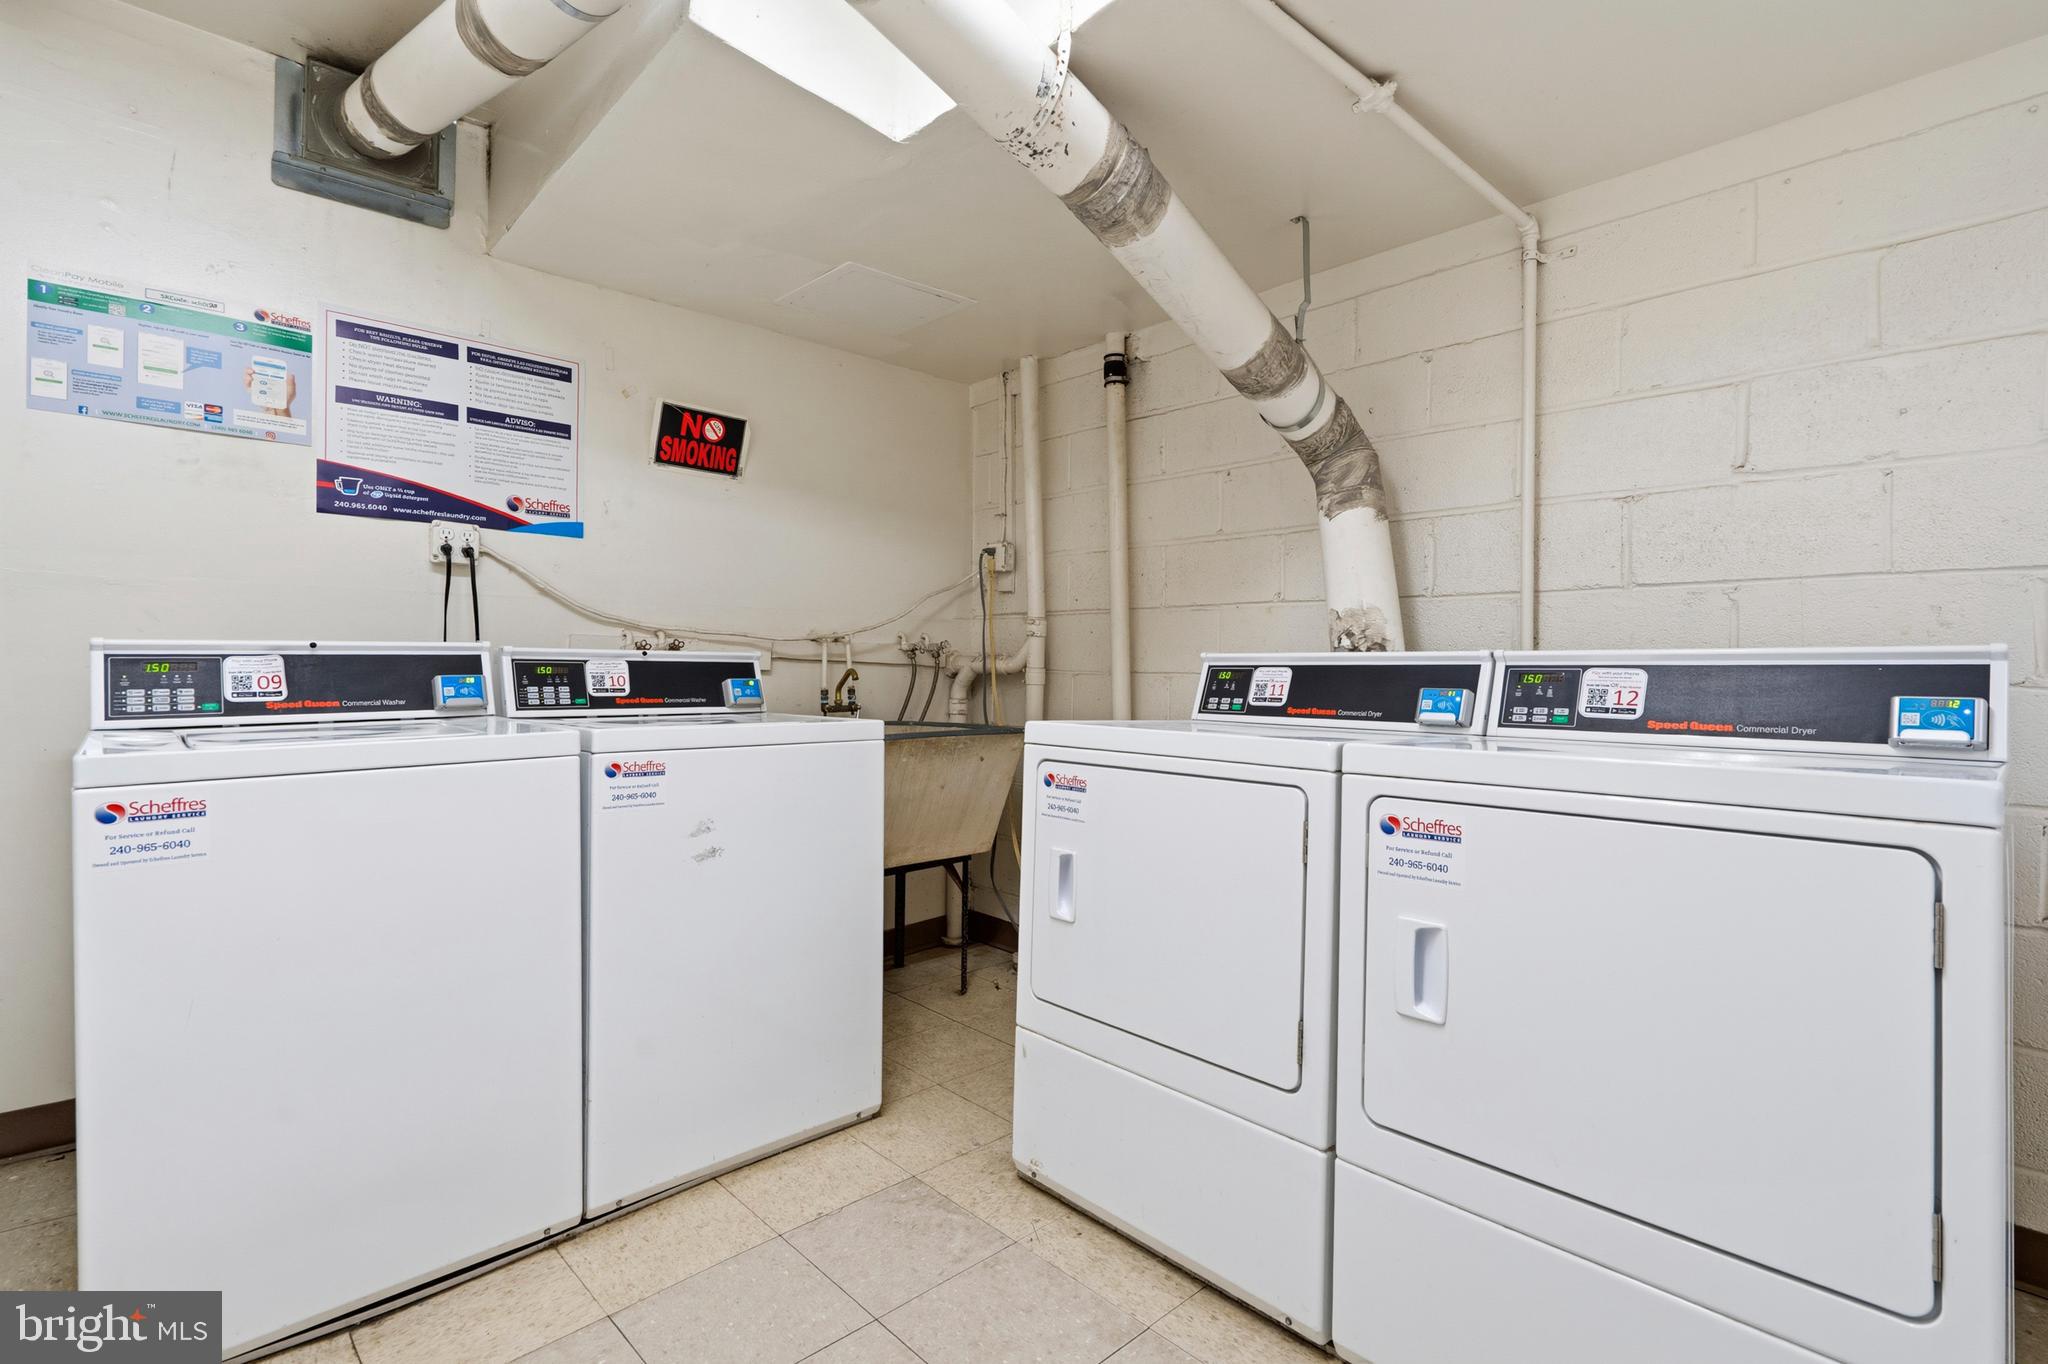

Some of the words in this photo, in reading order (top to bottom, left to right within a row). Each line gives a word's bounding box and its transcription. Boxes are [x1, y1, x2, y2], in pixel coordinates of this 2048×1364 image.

[88, 275, 125, 288] Mobile
[143, 304, 151, 313] 2
[236, 323, 245, 331] 3
[271, 312, 311, 329] Scheffres
[376, 394, 422, 408] WARNING:
[505, 416, 536, 428] ADVISO:
[660, 435, 737, 472] SMOKING
[334, 500, 388, 511] 240.965.6040
[393, 507, 487, 521] www.scheffreslaundry.com
[525, 498, 570, 513] Scheffres
[258, 674, 282, 690] 09
[609, 675, 626, 687] 10
[1270, 684, 1284, 696] 11
[616, 697, 640, 705] Speed
[640, 696, 664, 704] Queen
[1613, 690, 1639, 706] 12
[266, 700, 302, 711] Speed
[304, 700, 340, 708] Queen
[1287, 706, 1311, 716] Speed
[1312, 708, 1337, 716] Queen
[1338, 709, 1368, 718] Commercial
[1368, 710, 1383, 719] Dryer
[1647, 720, 1688, 731] Speed
[1689, 721, 1734, 733] Queen
[1736, 724, 1789, 735] Commercial
[1791, 726, 1817, 736] Dryer
[623, 760, 666, 772] Scheffres
[1056, 774, 1088, 788] Scheffres
[612, 792, 656, 802] 240-965-6040
[128, 797, 207, 816] Scheffres
[129, 814, 168, 822] LAUNDRY
[172, 811, 206, 819] SERVICE
[155, 828, 180, 836] Refund
[1402, 816, 1462, 836] Scheffres
[1403, 832, 1431, 840] LAUNDRY
[1434, 835, 1461, 844] SERVICE
[110, 840, 191, 856] 240-965-6040
[1396, 846, 1414, 854] Service
[1388, 856, 1449, 874] 240-965-6040
